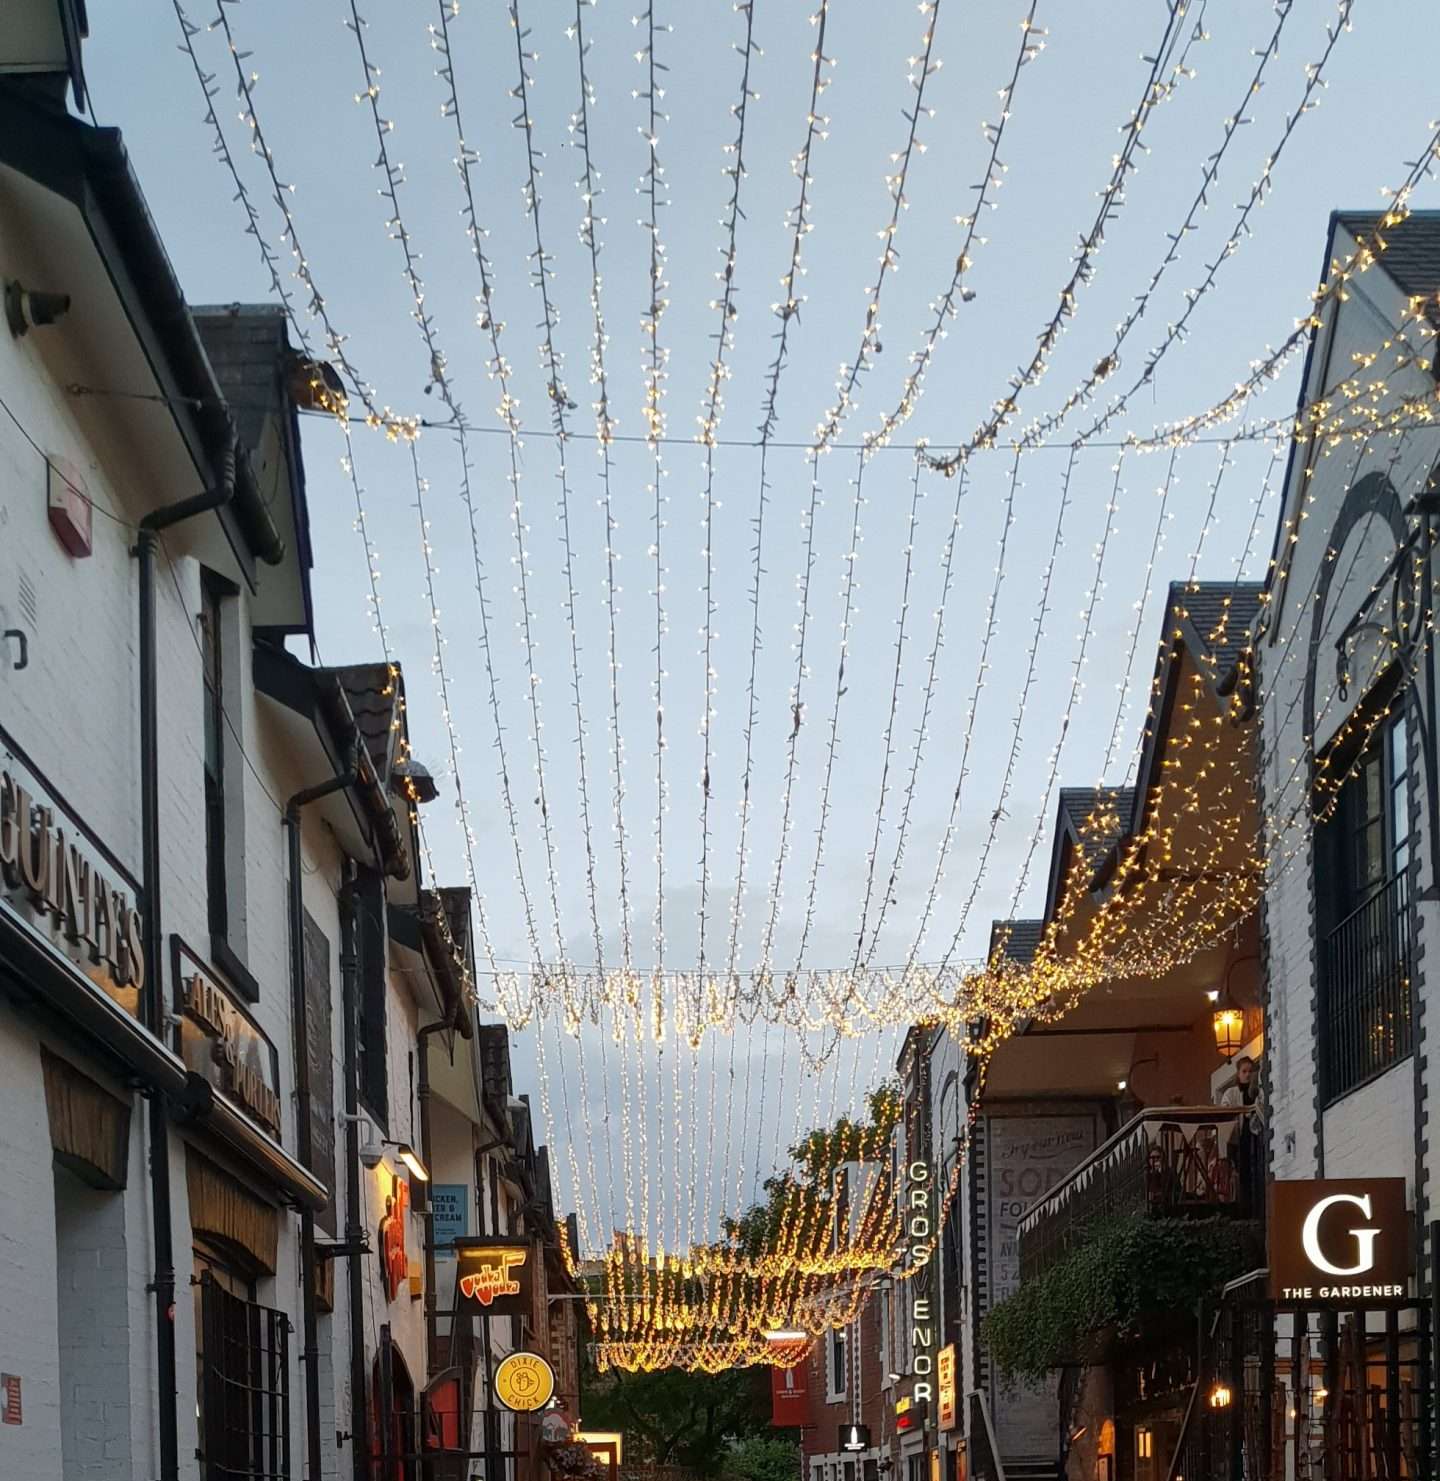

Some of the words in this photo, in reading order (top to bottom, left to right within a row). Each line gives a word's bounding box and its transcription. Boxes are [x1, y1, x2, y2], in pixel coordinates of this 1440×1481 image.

[1302, 1193, 1382, 1276] G
[909, 1160, 933, 1404] GROSVENOR
[1283, 1287, 1312, 1299] THE
[1319, 1285, 1403, 1298] GARDENER
[510, 1357, 539, 1369] DIXIE
[508, 1394, 539, 1407] CHICK
